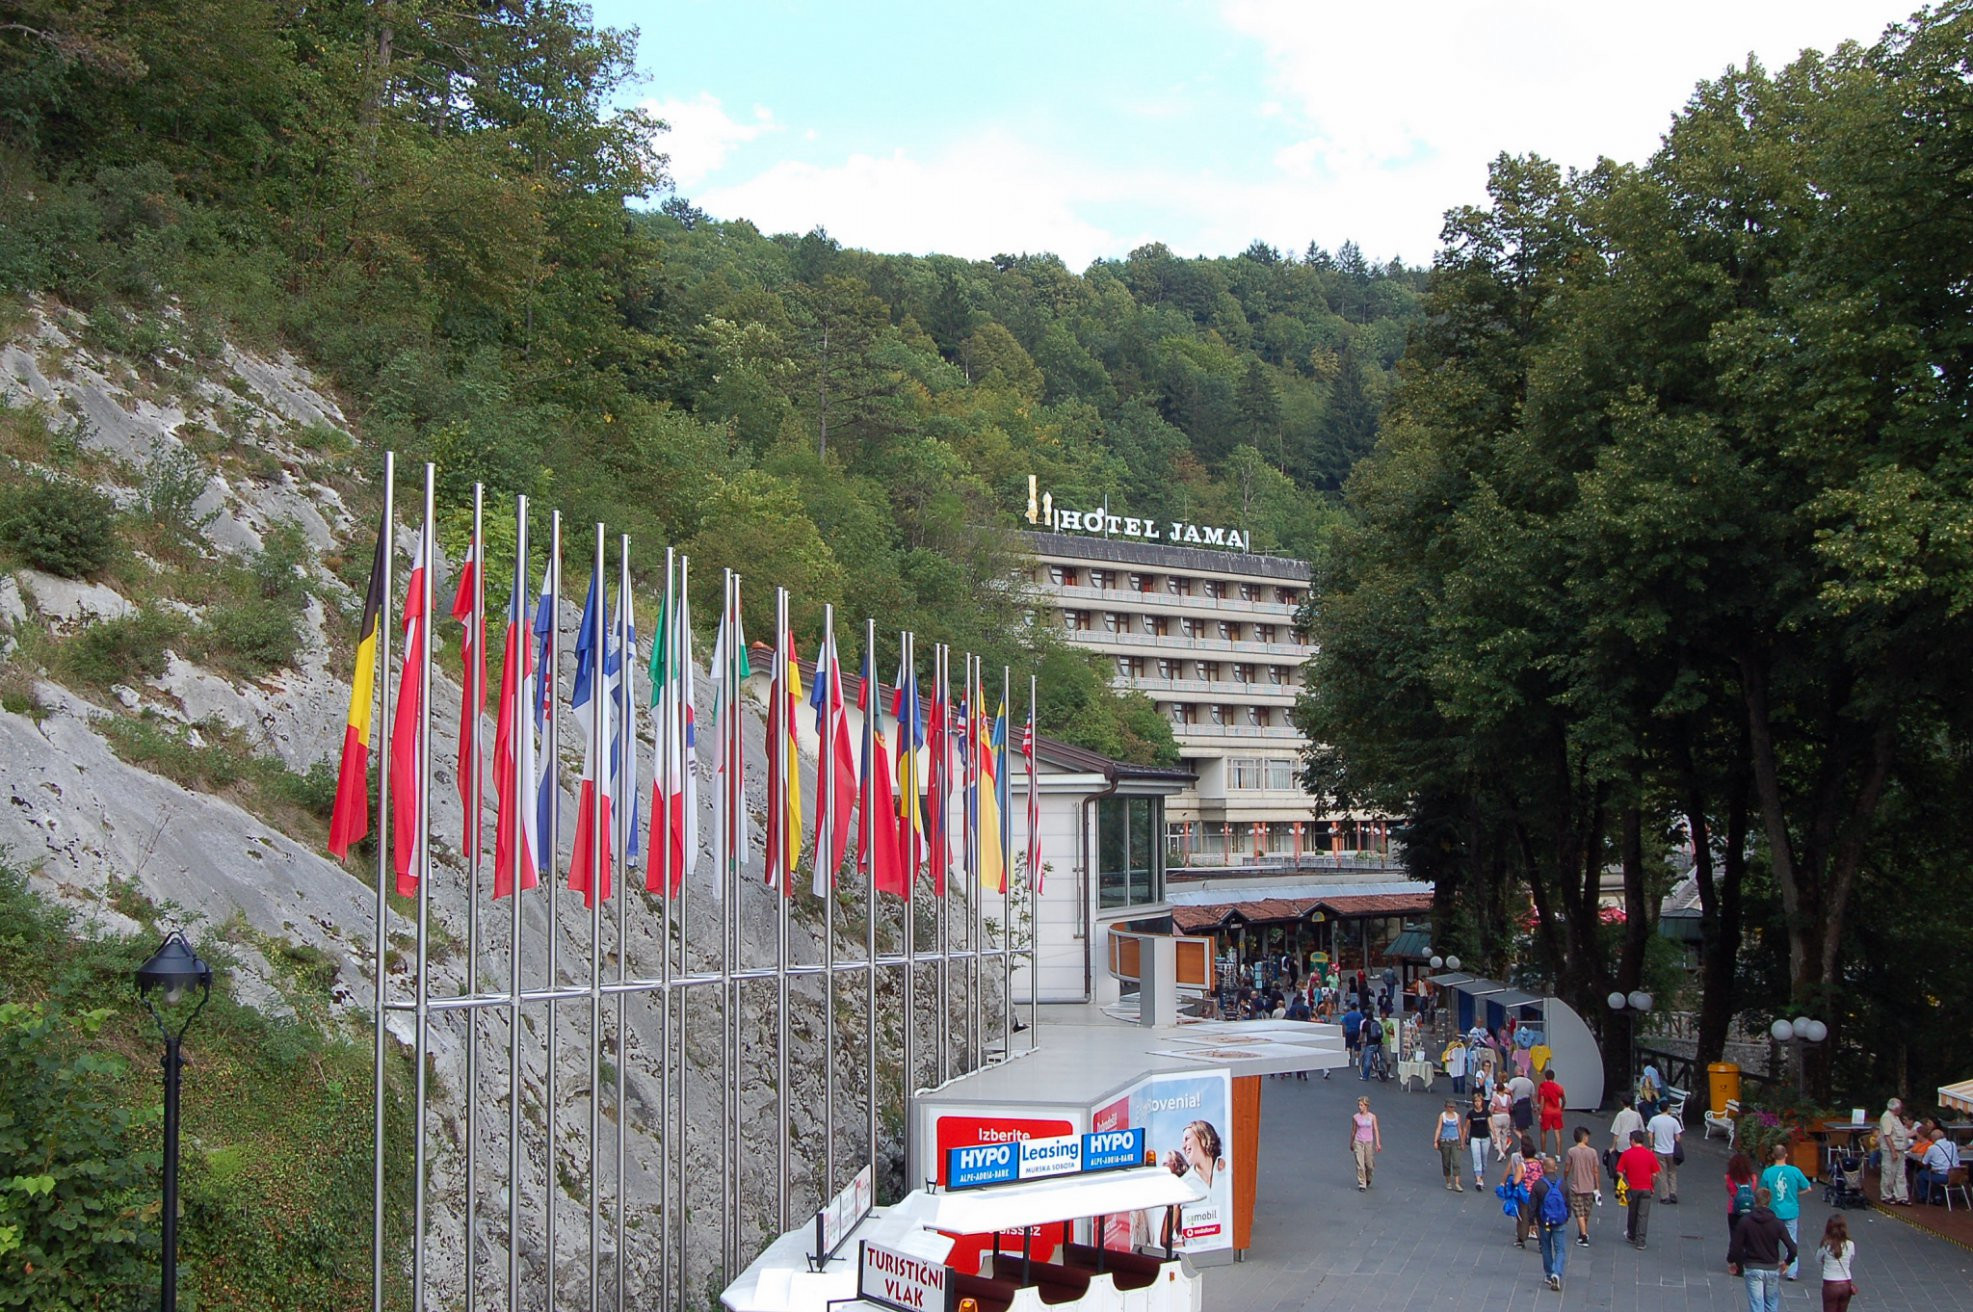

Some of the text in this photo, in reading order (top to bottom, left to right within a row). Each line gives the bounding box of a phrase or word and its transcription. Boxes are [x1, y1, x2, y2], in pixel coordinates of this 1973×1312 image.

[1060, 509, 1244, 548] HOTEL JAMA
[979, 1127, 1031, 1142] Izberite
[1090, 1132, 1134, 1153] HYPO
[960, 1146, 1010, 1169] HYPO
[1022, 1140, 1079, 1161] Leasing
[867, 1247, 943, 1291] TURISTIČNI
[885, 1278, 923, 1308] VLAK
